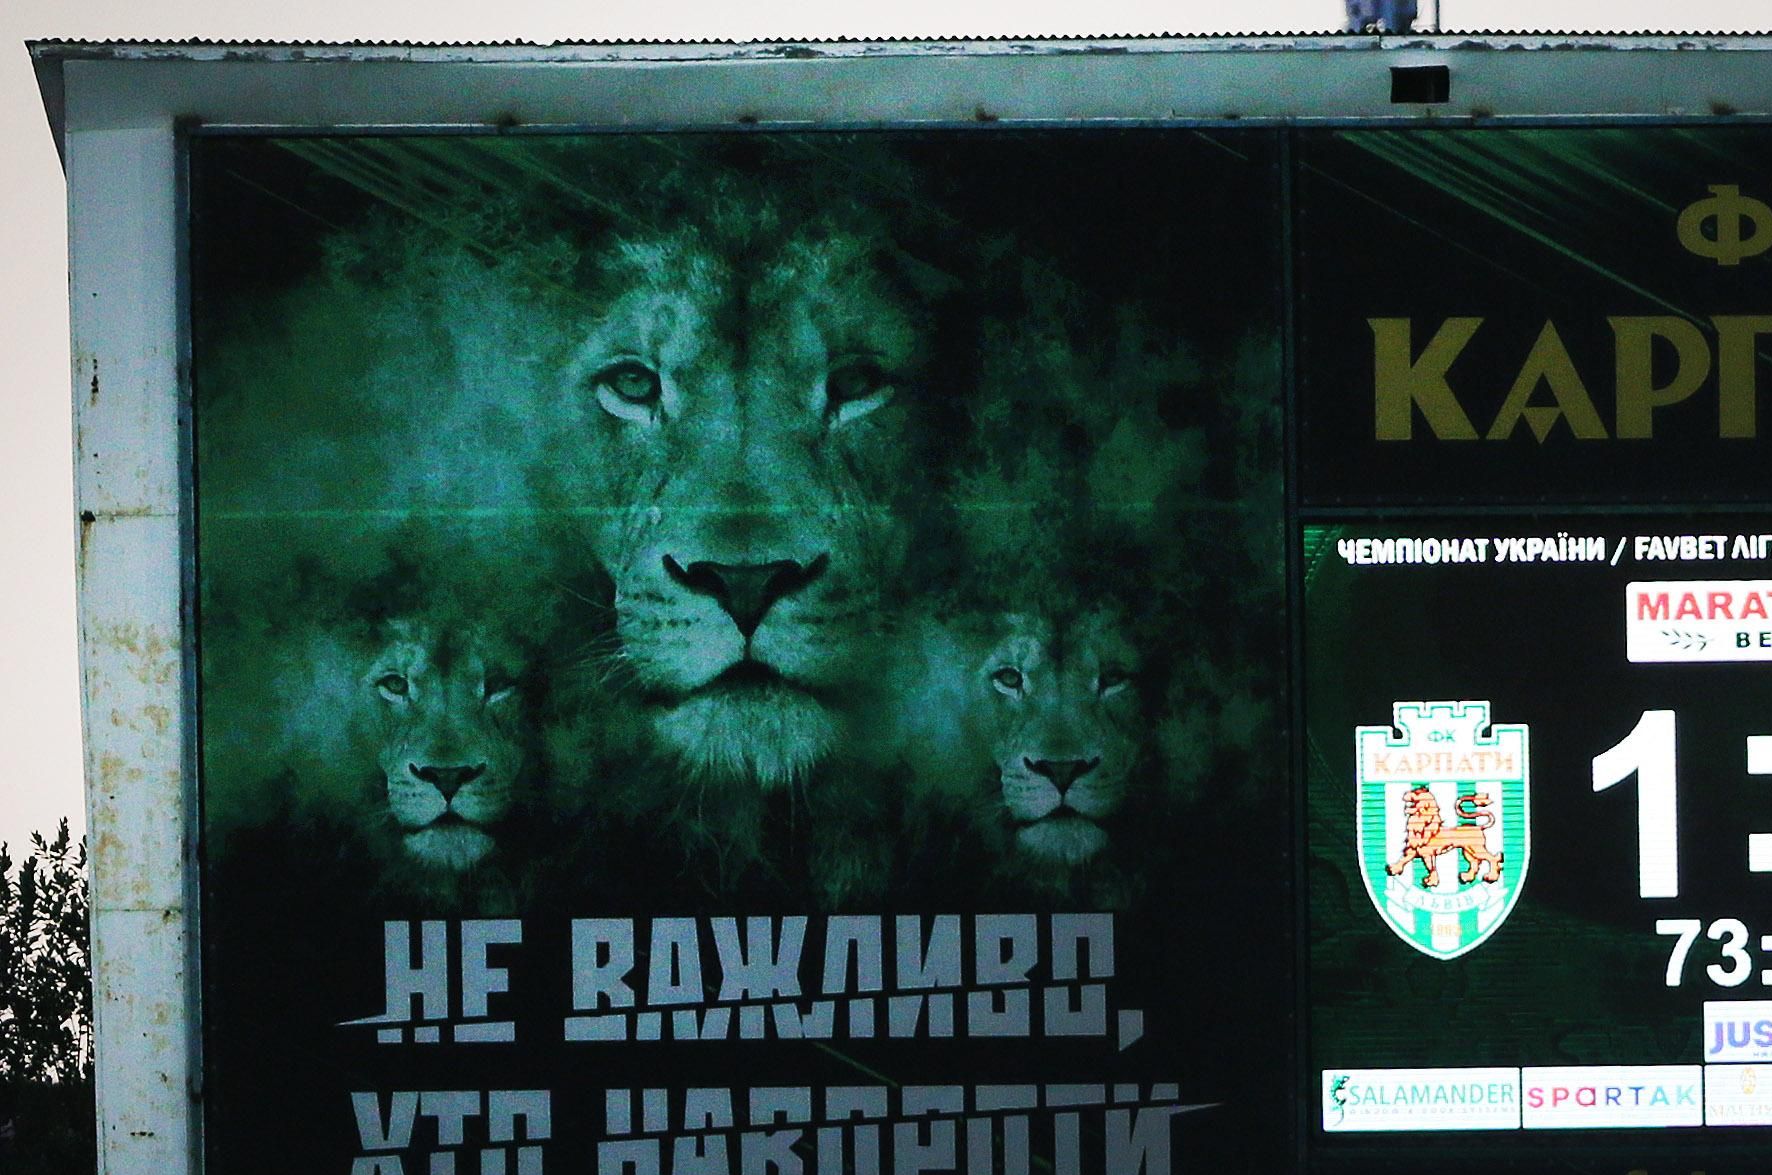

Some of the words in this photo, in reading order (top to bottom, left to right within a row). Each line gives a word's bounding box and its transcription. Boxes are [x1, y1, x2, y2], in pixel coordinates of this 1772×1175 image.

[1338, 537, 1489, 565] ЧЕМПІОНАТ
[1495, 532, 1606, 563] УКРАЇНИ
[1635, 535, 1727, 560] FAVBET
[1427, 729, 1456, 742] ФК
[1373, 752, 1515, 775] КАРПАТИ
[375, 918, 523, 1044] НЕ
[564, 912, 1144, 1052] ВАЖЛИВО,
[1350, 1083, 1515, 1105] SALAMANDER
